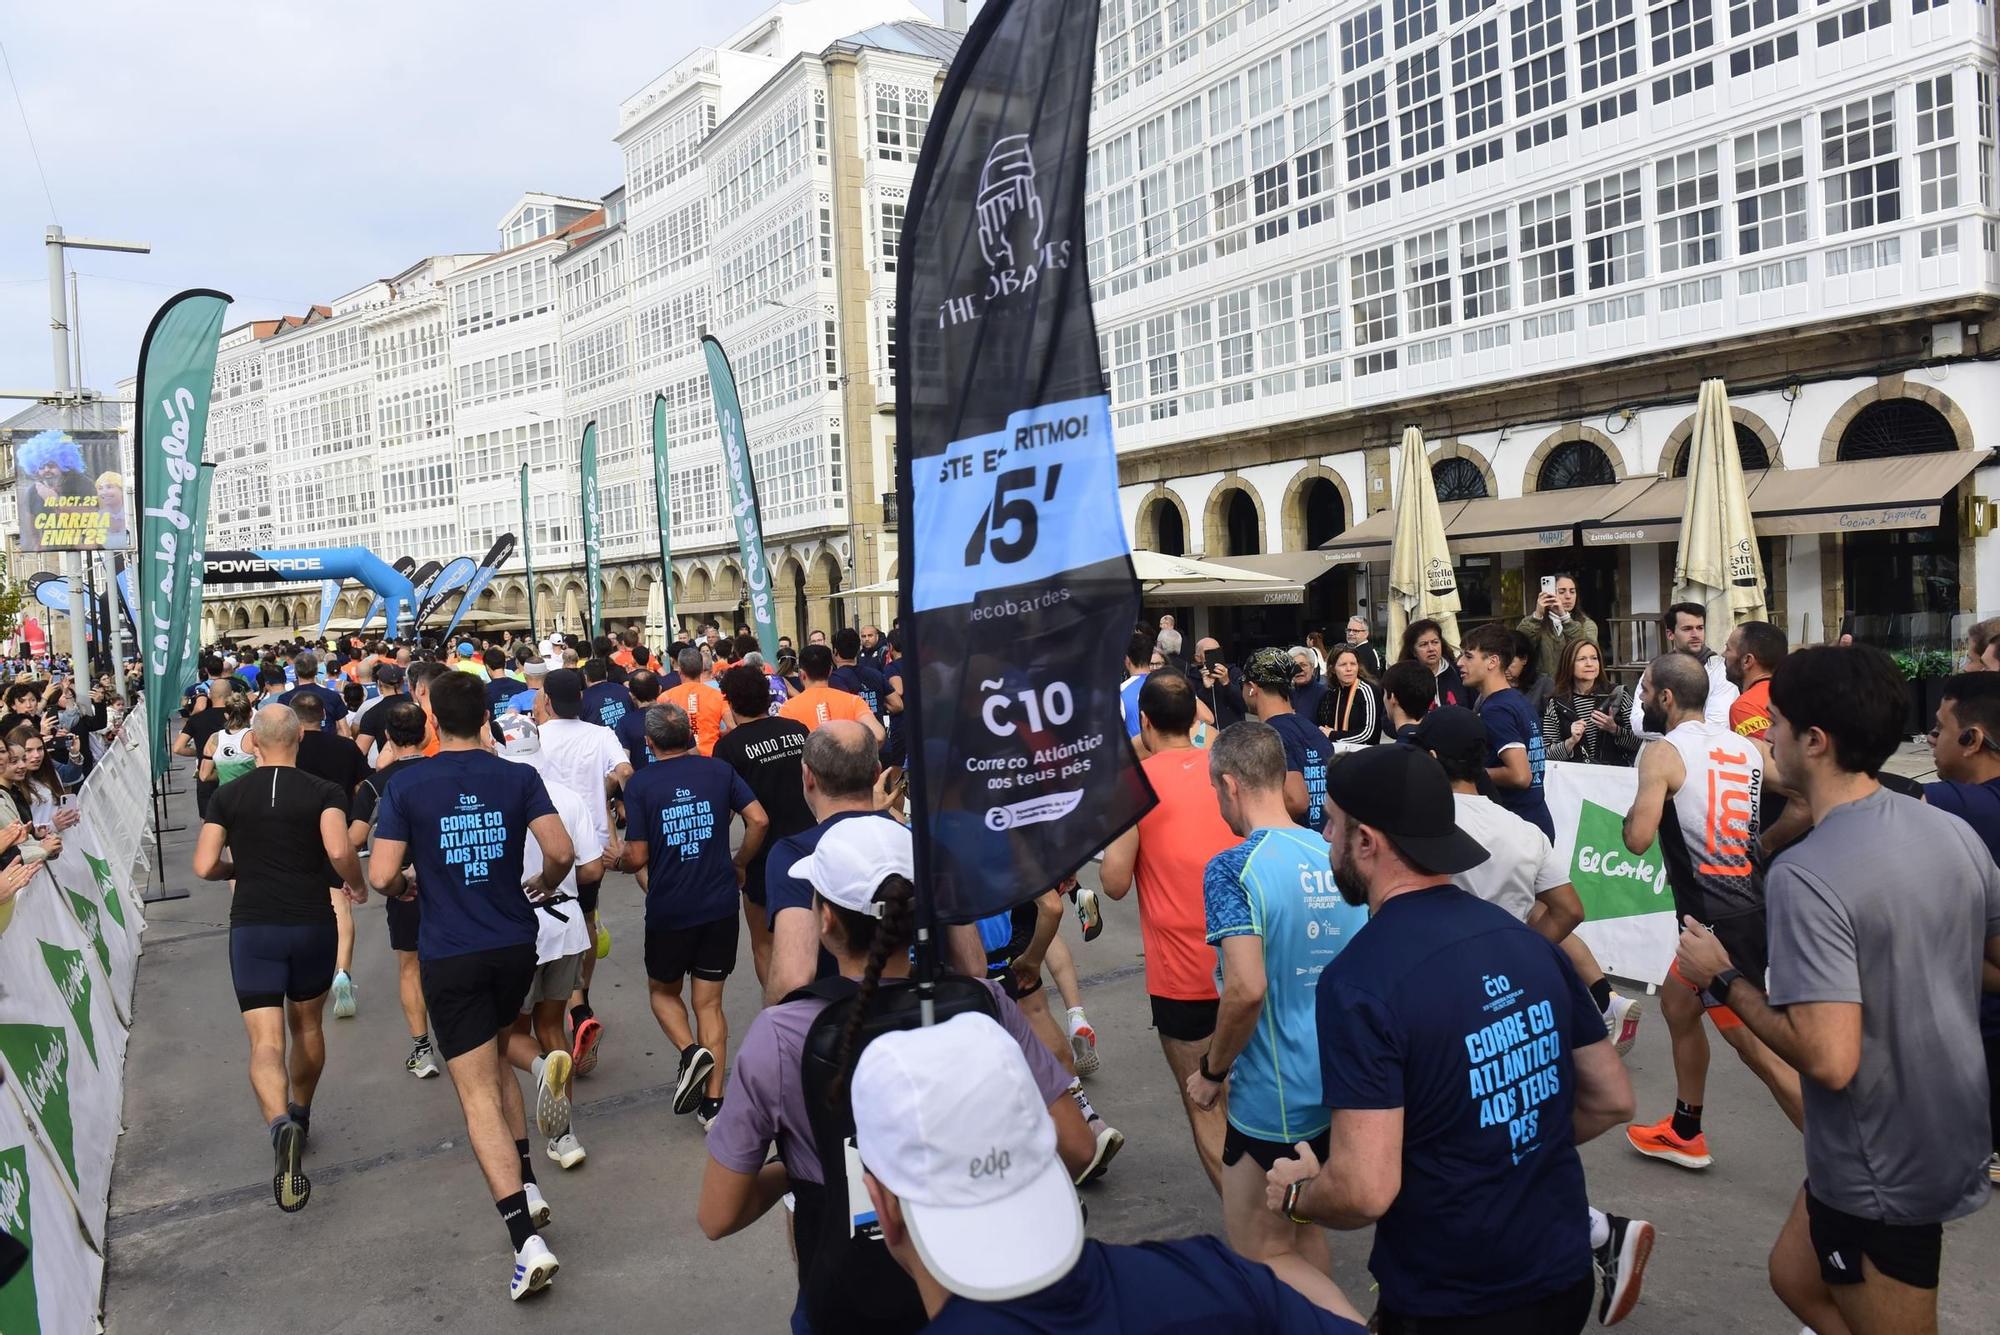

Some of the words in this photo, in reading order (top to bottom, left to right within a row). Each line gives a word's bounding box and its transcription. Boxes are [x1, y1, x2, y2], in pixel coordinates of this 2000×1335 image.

[1015, 415, 1088, 452] RITMO!
[144, 387, 197, 530] Inglés
[34, 512, 111, 529] CARRERA
[1880, 507, 1928, 523] Inquieta
[203, 557, 322, 574] POWERADE
[466, 543, 512, 600] POWERADE
[416, 563, 469, 631] POWERADE
[970, 586, 1072, 622] ecobardes
[745, 738, 778, 760] ÓXIDO
[780, 733, 805, 749] ZERO
[760, 751, 787, 764] TRAINING
[966, 756, 1006, 773] Corre
[1007, 756, 1028, 770] co
[1033, 733, 1104, 766] Atlántico
[987, 777, 1013, 790] aos
[1016, 766, 1056, 786] teus
[1060, 758, 1092, 780] pés
[440, 814, 482, 832] CORRE
[484, 811, 503, 827] CO
[662, 803, 695, 821] CORRE
[696, 800, 711, 814] CO
[662, 813, 714, 835] ATLÁNTICO
[440, 827, 506, 849] ATLÁNTICO
[667, 831, 686, 847] AOS
[688, 826, 712, 841] TEUS
[681, 841, 699, 856] PÉS
[446, 847, 471, 865] AOS
[473, 843, 504, 860] TEUS
[465, 859, 488, 878] PÉS
[1579, 846, 1601, 873] El
[1601, 851, 1654, 882] Corte
[1465, 1011, 1529, 1064] CORRE
[1527, 1000, 1555, 1035] CO
[1469, 1031, 1560, 1099] ATLÁNTICO
[1480, 1087, 1516, 1128] AOS
[1519, 1064, 1560, 1110] TEUS
[1509, 1109, 1539, 1149] PÉS
[969, 1146, 1011, 1180] edp
